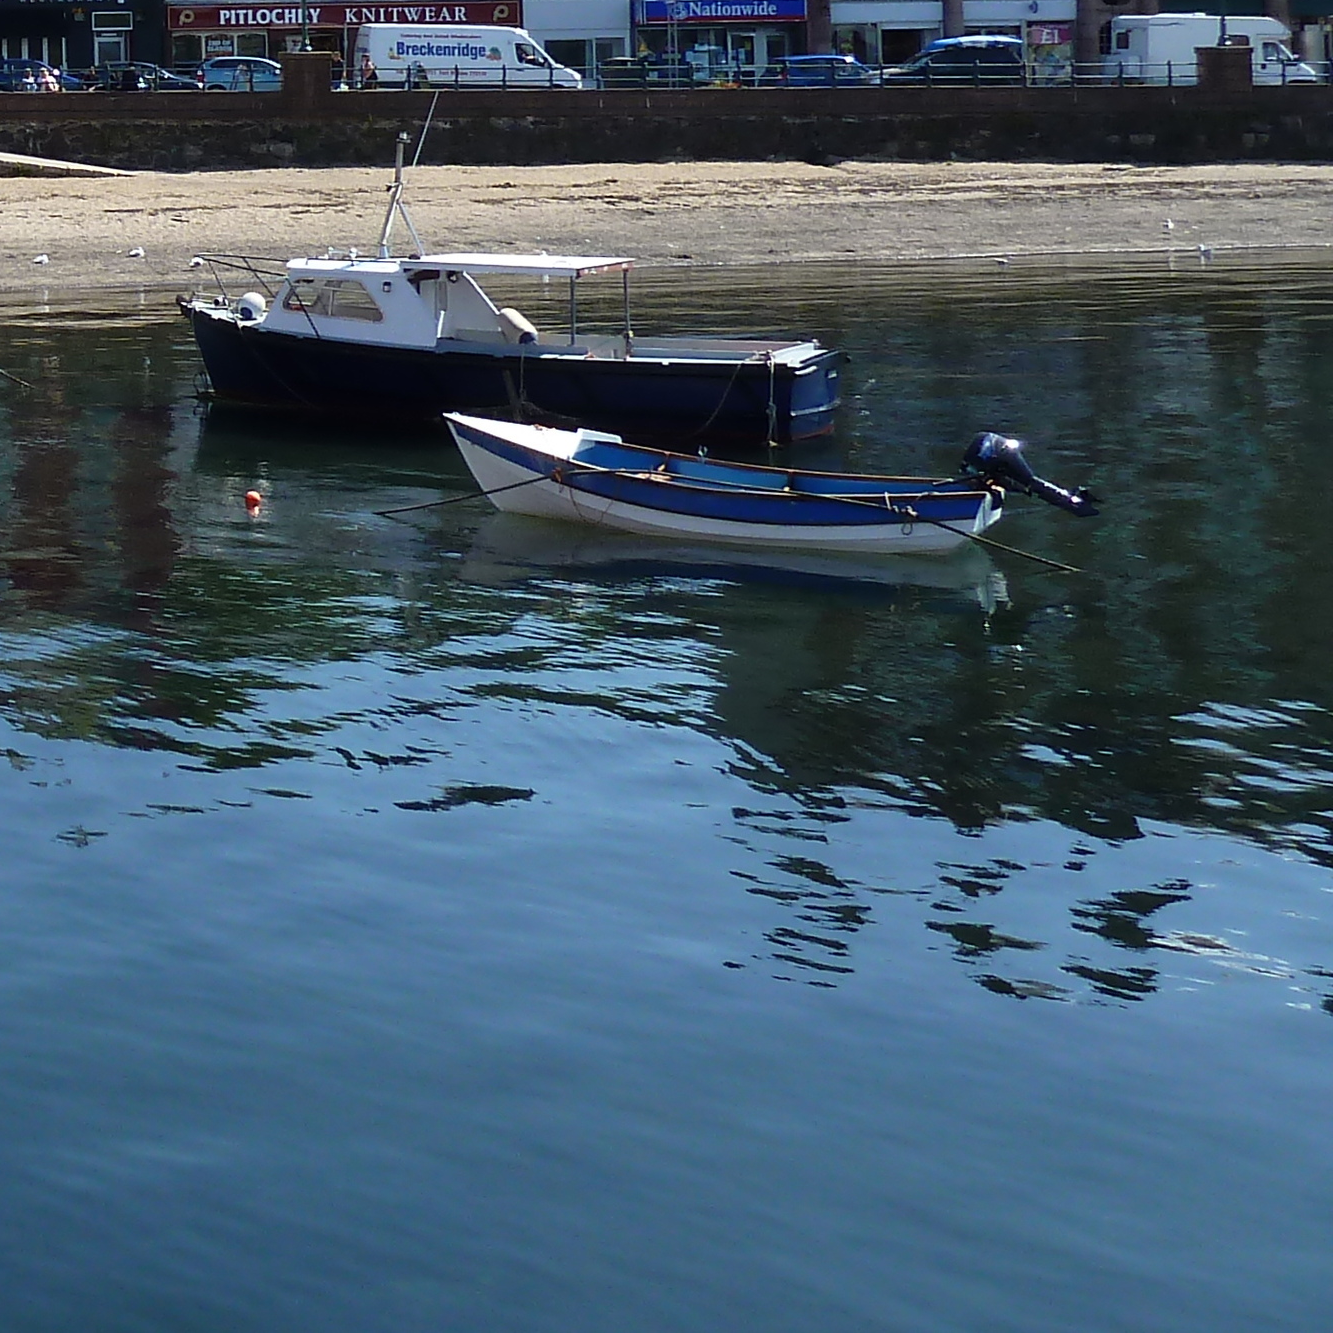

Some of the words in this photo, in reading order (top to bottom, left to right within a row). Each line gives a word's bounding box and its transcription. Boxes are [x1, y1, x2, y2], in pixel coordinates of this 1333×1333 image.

[220, 8, 321, 24] PITLOCHRY
[345, 7, 468, 23] KNITWEAR
[689, 1, 777, 17] Nationwide
[397, 41, 486, 60] Breckenridge
